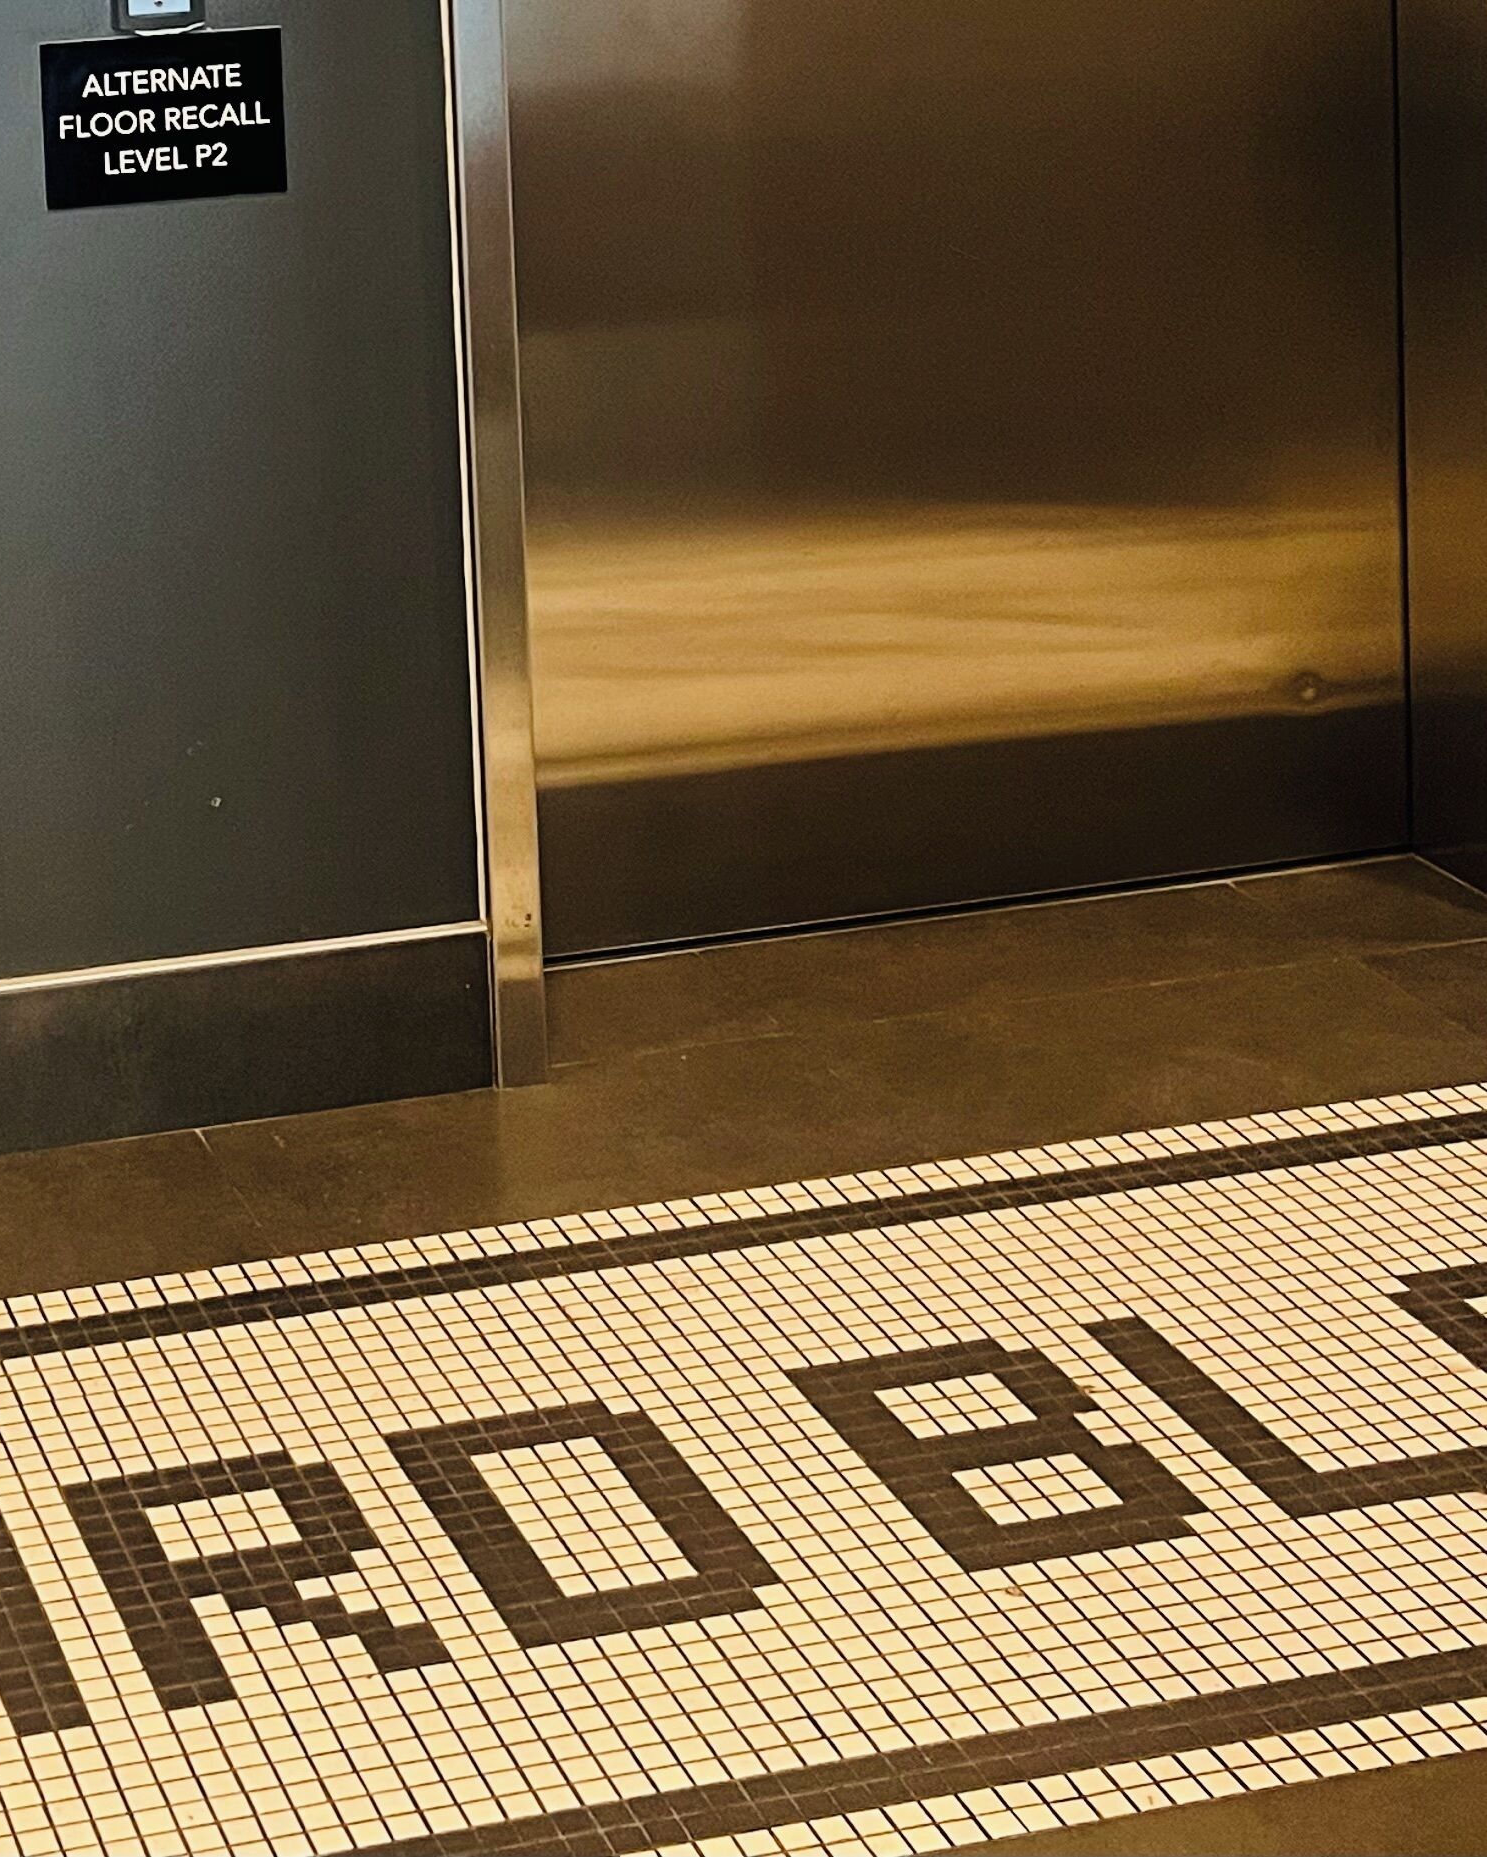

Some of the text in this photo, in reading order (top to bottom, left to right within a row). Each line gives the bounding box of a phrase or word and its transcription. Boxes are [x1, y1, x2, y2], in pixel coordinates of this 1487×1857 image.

[82, 62, 242, 98] ALTERNATE
[59, 100, 271, 139] FLOOR RECALL
[104, 141, 228, 175] LEVEL P2
